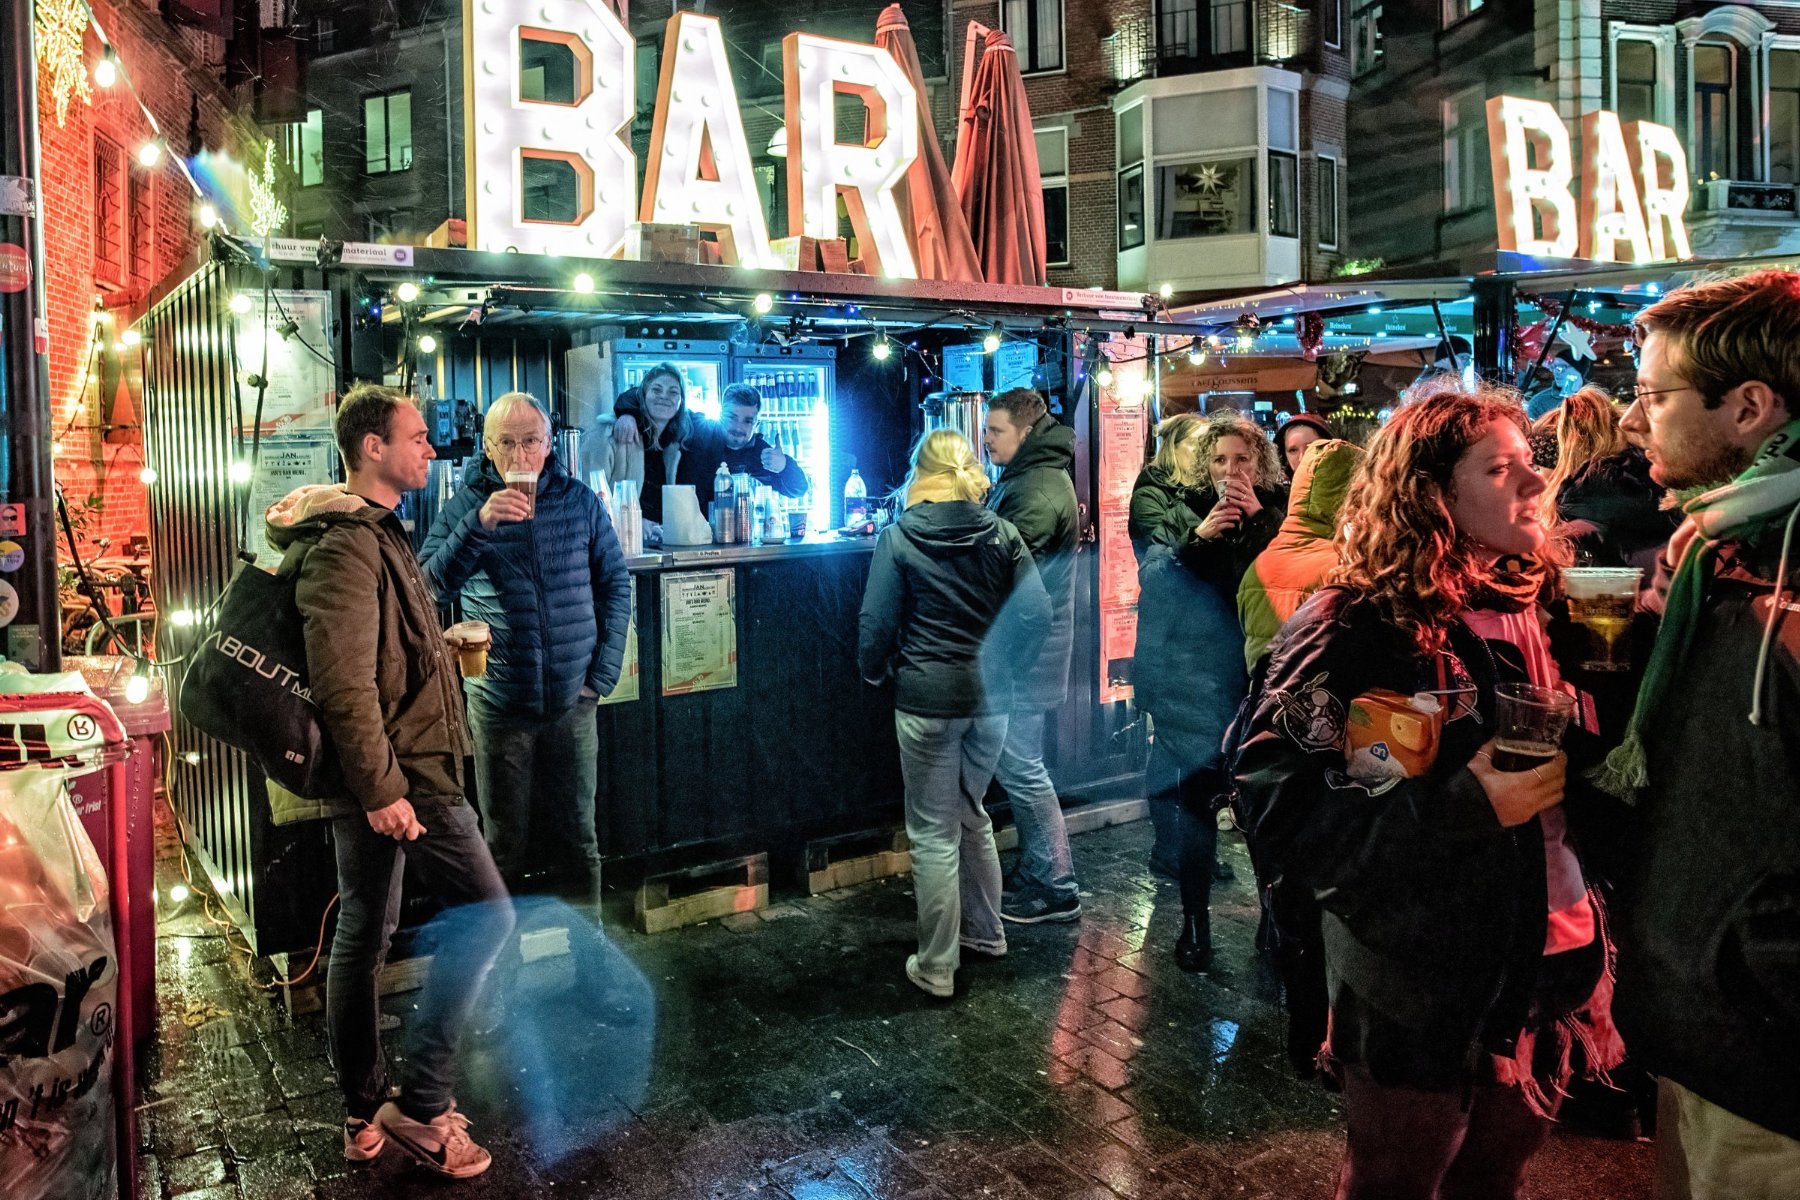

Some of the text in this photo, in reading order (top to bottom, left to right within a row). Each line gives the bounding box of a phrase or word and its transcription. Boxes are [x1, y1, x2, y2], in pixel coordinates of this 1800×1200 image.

[464, 0, 918, 280] BAR
[1486, 95, 1694, 263] BAR
[343, 248, 387, 257] materiaal
[1329, 322, 1352, 330] Heineken
[212, 630, 299, 687] ABOUT
